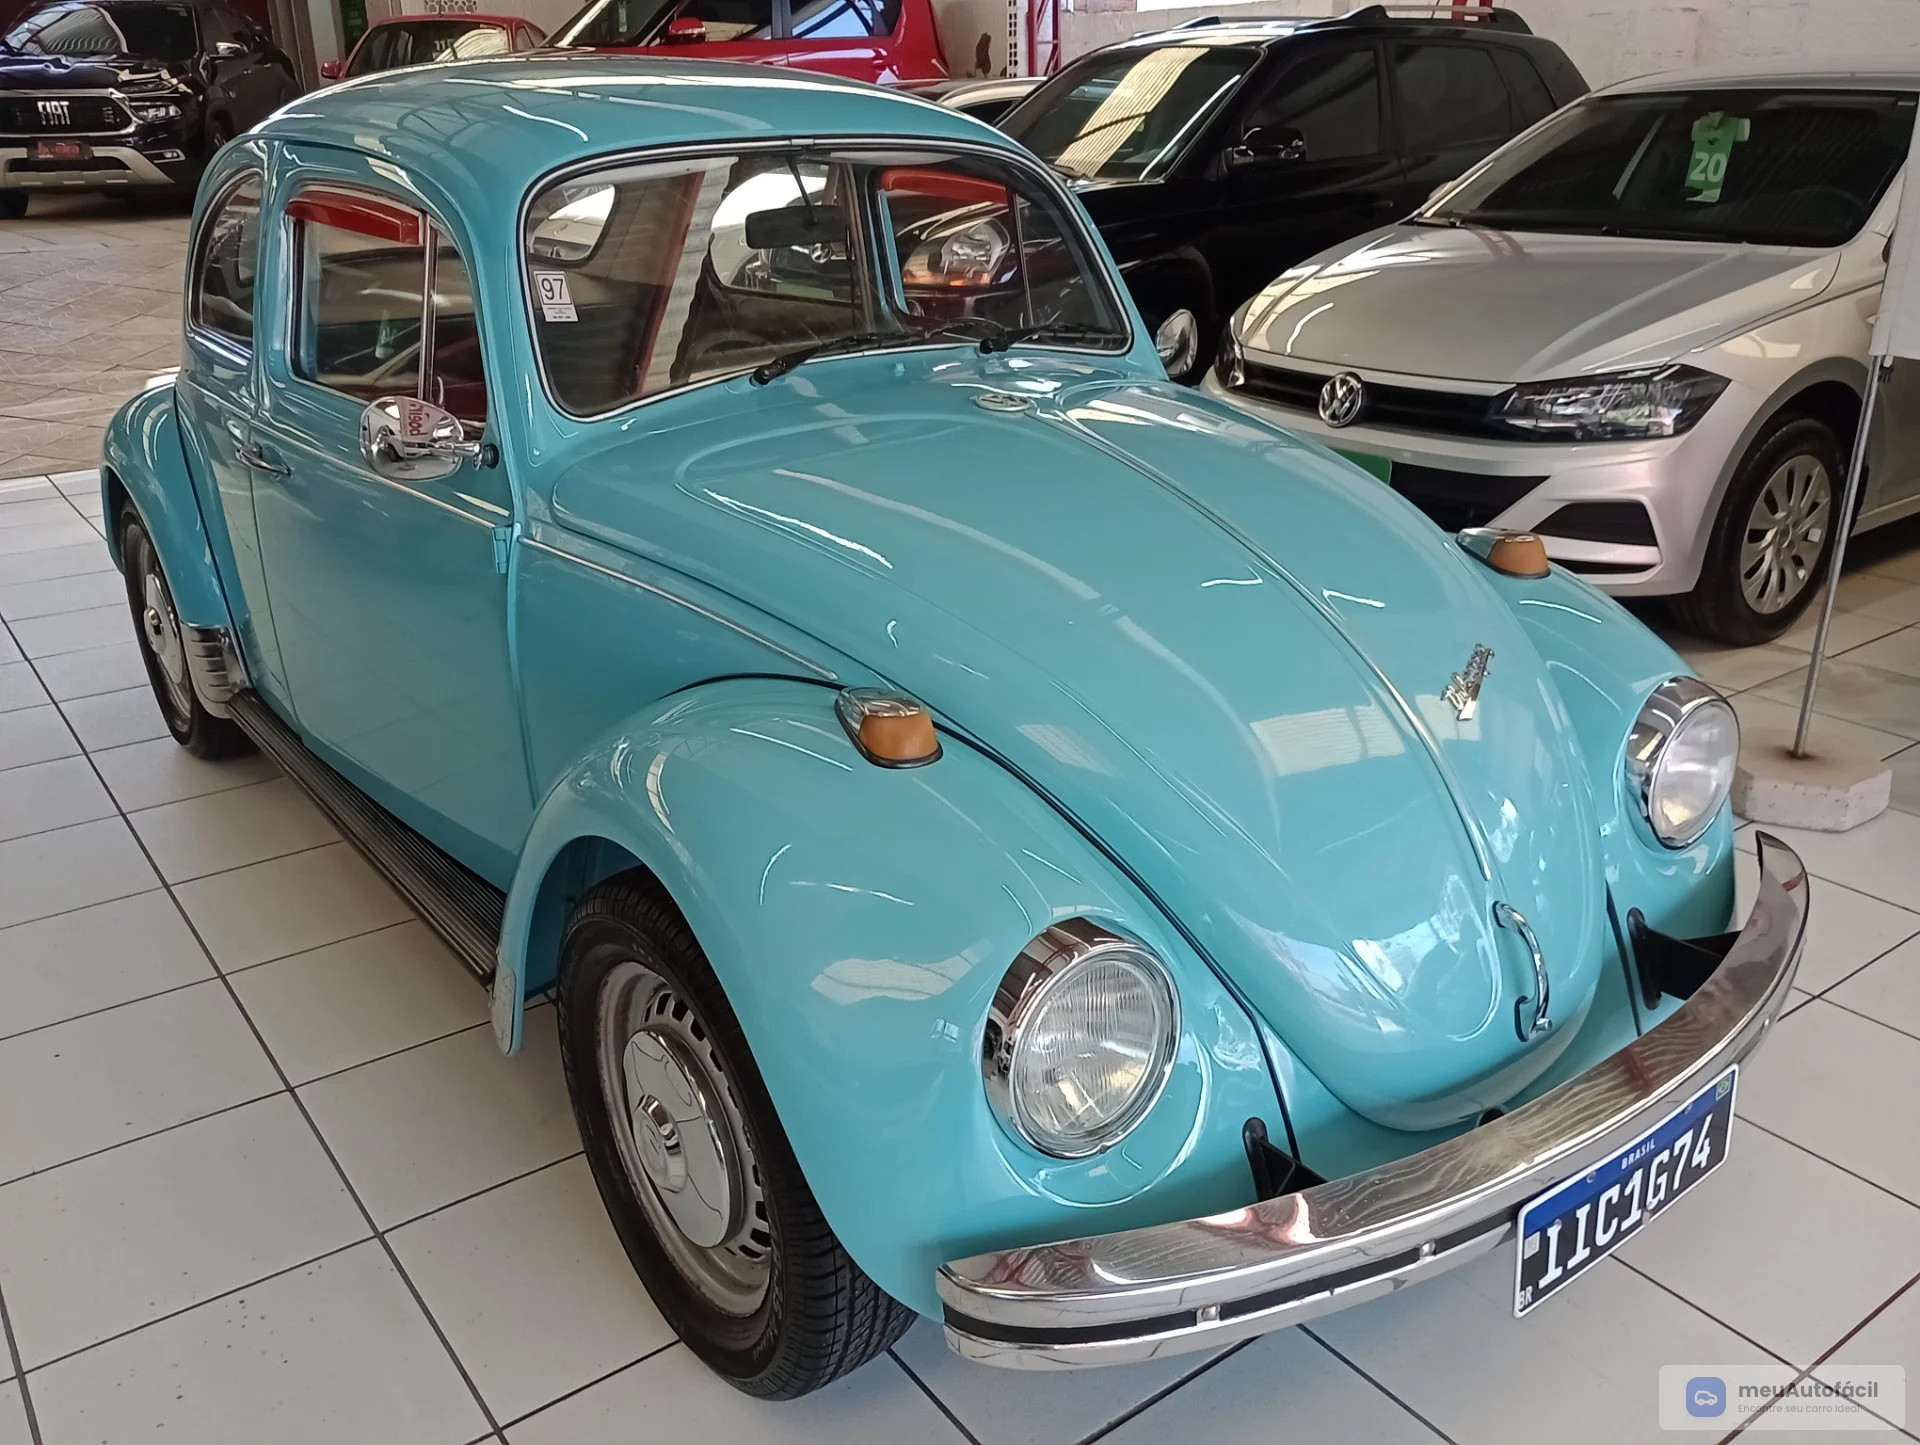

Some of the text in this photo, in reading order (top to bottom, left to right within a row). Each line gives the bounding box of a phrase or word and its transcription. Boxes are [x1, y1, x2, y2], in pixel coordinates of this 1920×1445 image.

[37, 101, 70, 125] FIAT
[1690, 152, 1727, 182] 20
[541, 278, 564, 300] 97
[1621, 1139, 1656, 1170] BRASIL
[1538, 1113, 1713, 1289] IIC1G74
[1518, 1286, 1532, 1310] BR
